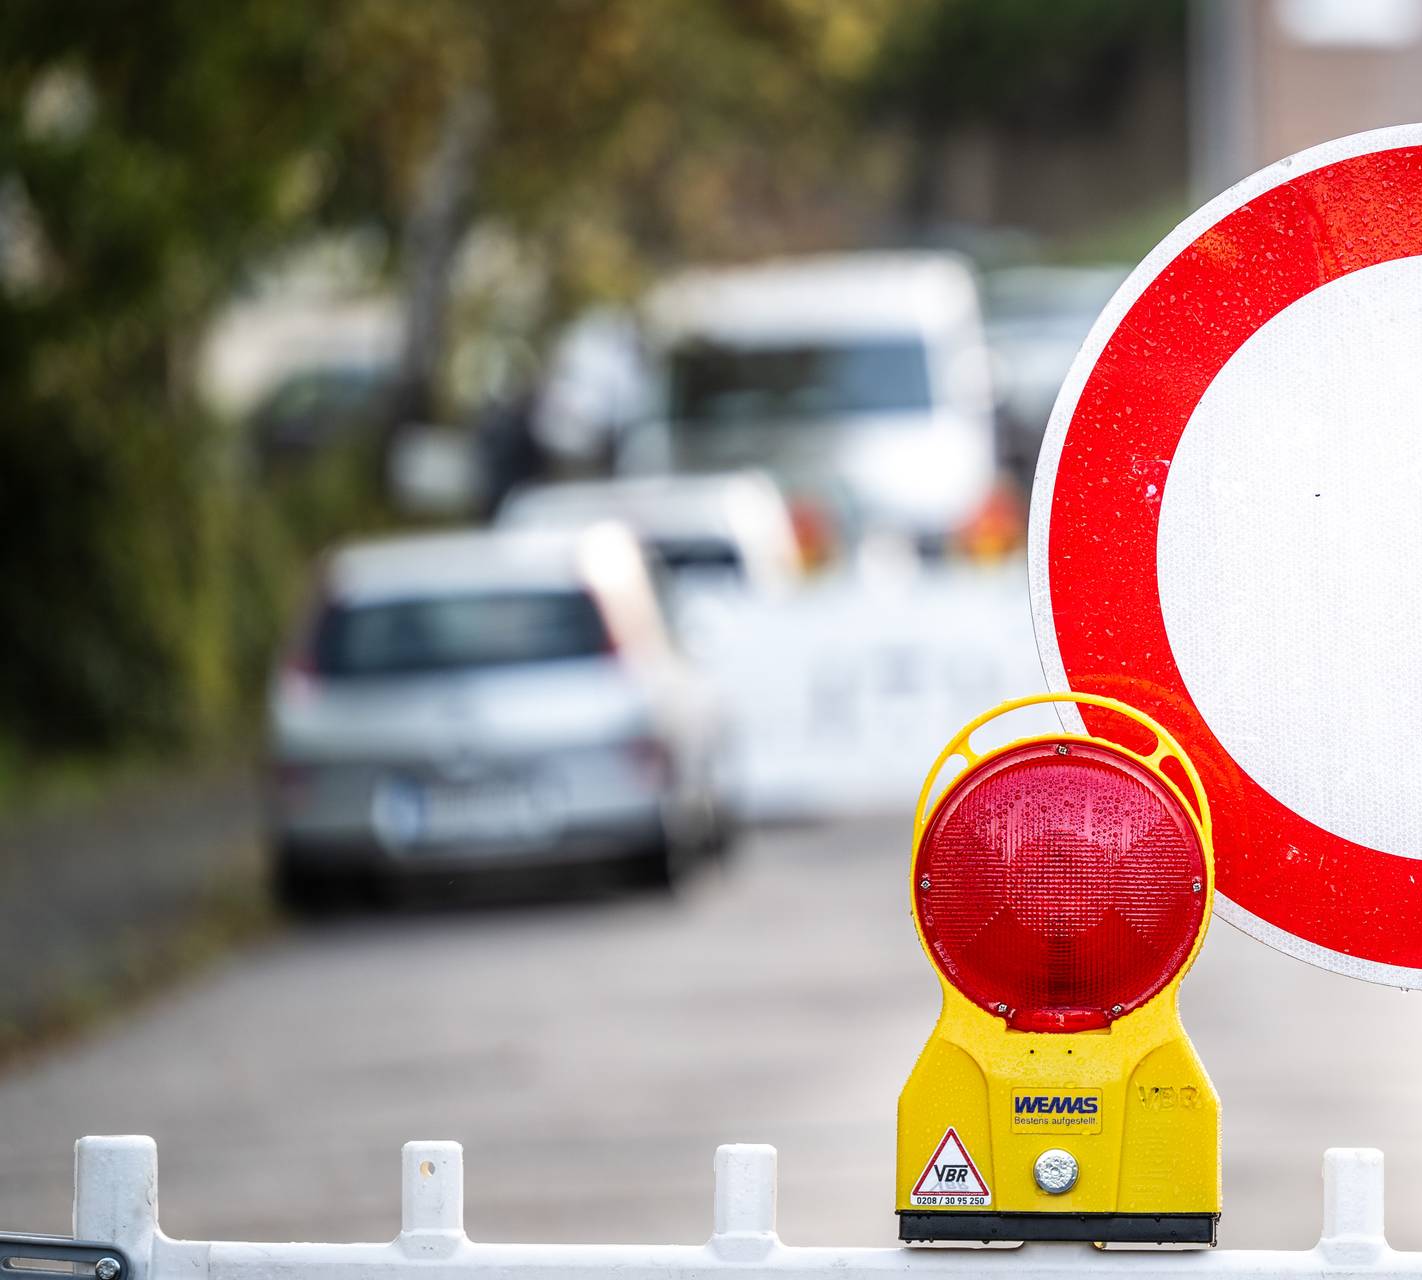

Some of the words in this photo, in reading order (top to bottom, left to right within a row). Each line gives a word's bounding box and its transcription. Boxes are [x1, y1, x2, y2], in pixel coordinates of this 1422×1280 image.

[1014, 1096, 1098, 1114] WEMAS
[1014, 1116, 1049, 1125] Bestens
[933, 1164, 969, 1183] VBR
[916, 1196, 937, 1205] 0208
[945, 1196, 955, 1205] 30
[957, 1196, 968, 1205] 95
[969, 1196, 985, 1205] 250
